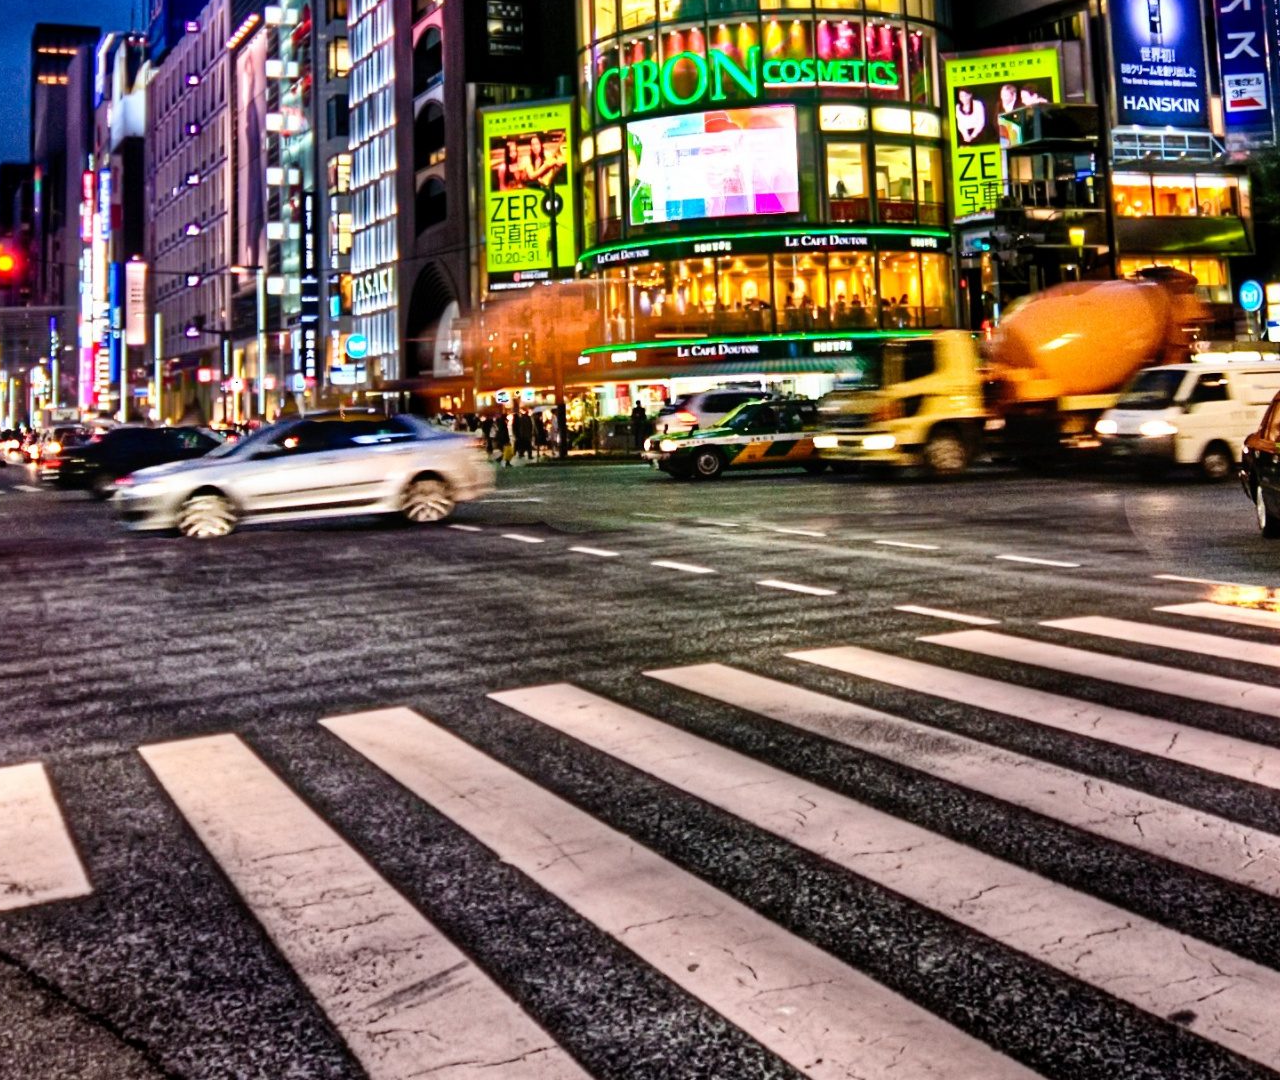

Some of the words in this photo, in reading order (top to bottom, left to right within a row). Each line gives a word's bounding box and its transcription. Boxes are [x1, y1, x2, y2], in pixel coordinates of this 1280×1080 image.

[762, 57, 900, 86] COSMETICS
[1123, 95, 1200, 113] HANSKIN
[490, 222, 539, 252] 写真展
[785, 236, 798, 247] LE
[829, 235, 868, 247] DOUTOR
[351, 268, 393, 303] TASAKI
[718, 343, 760, 355] DOUTOR
